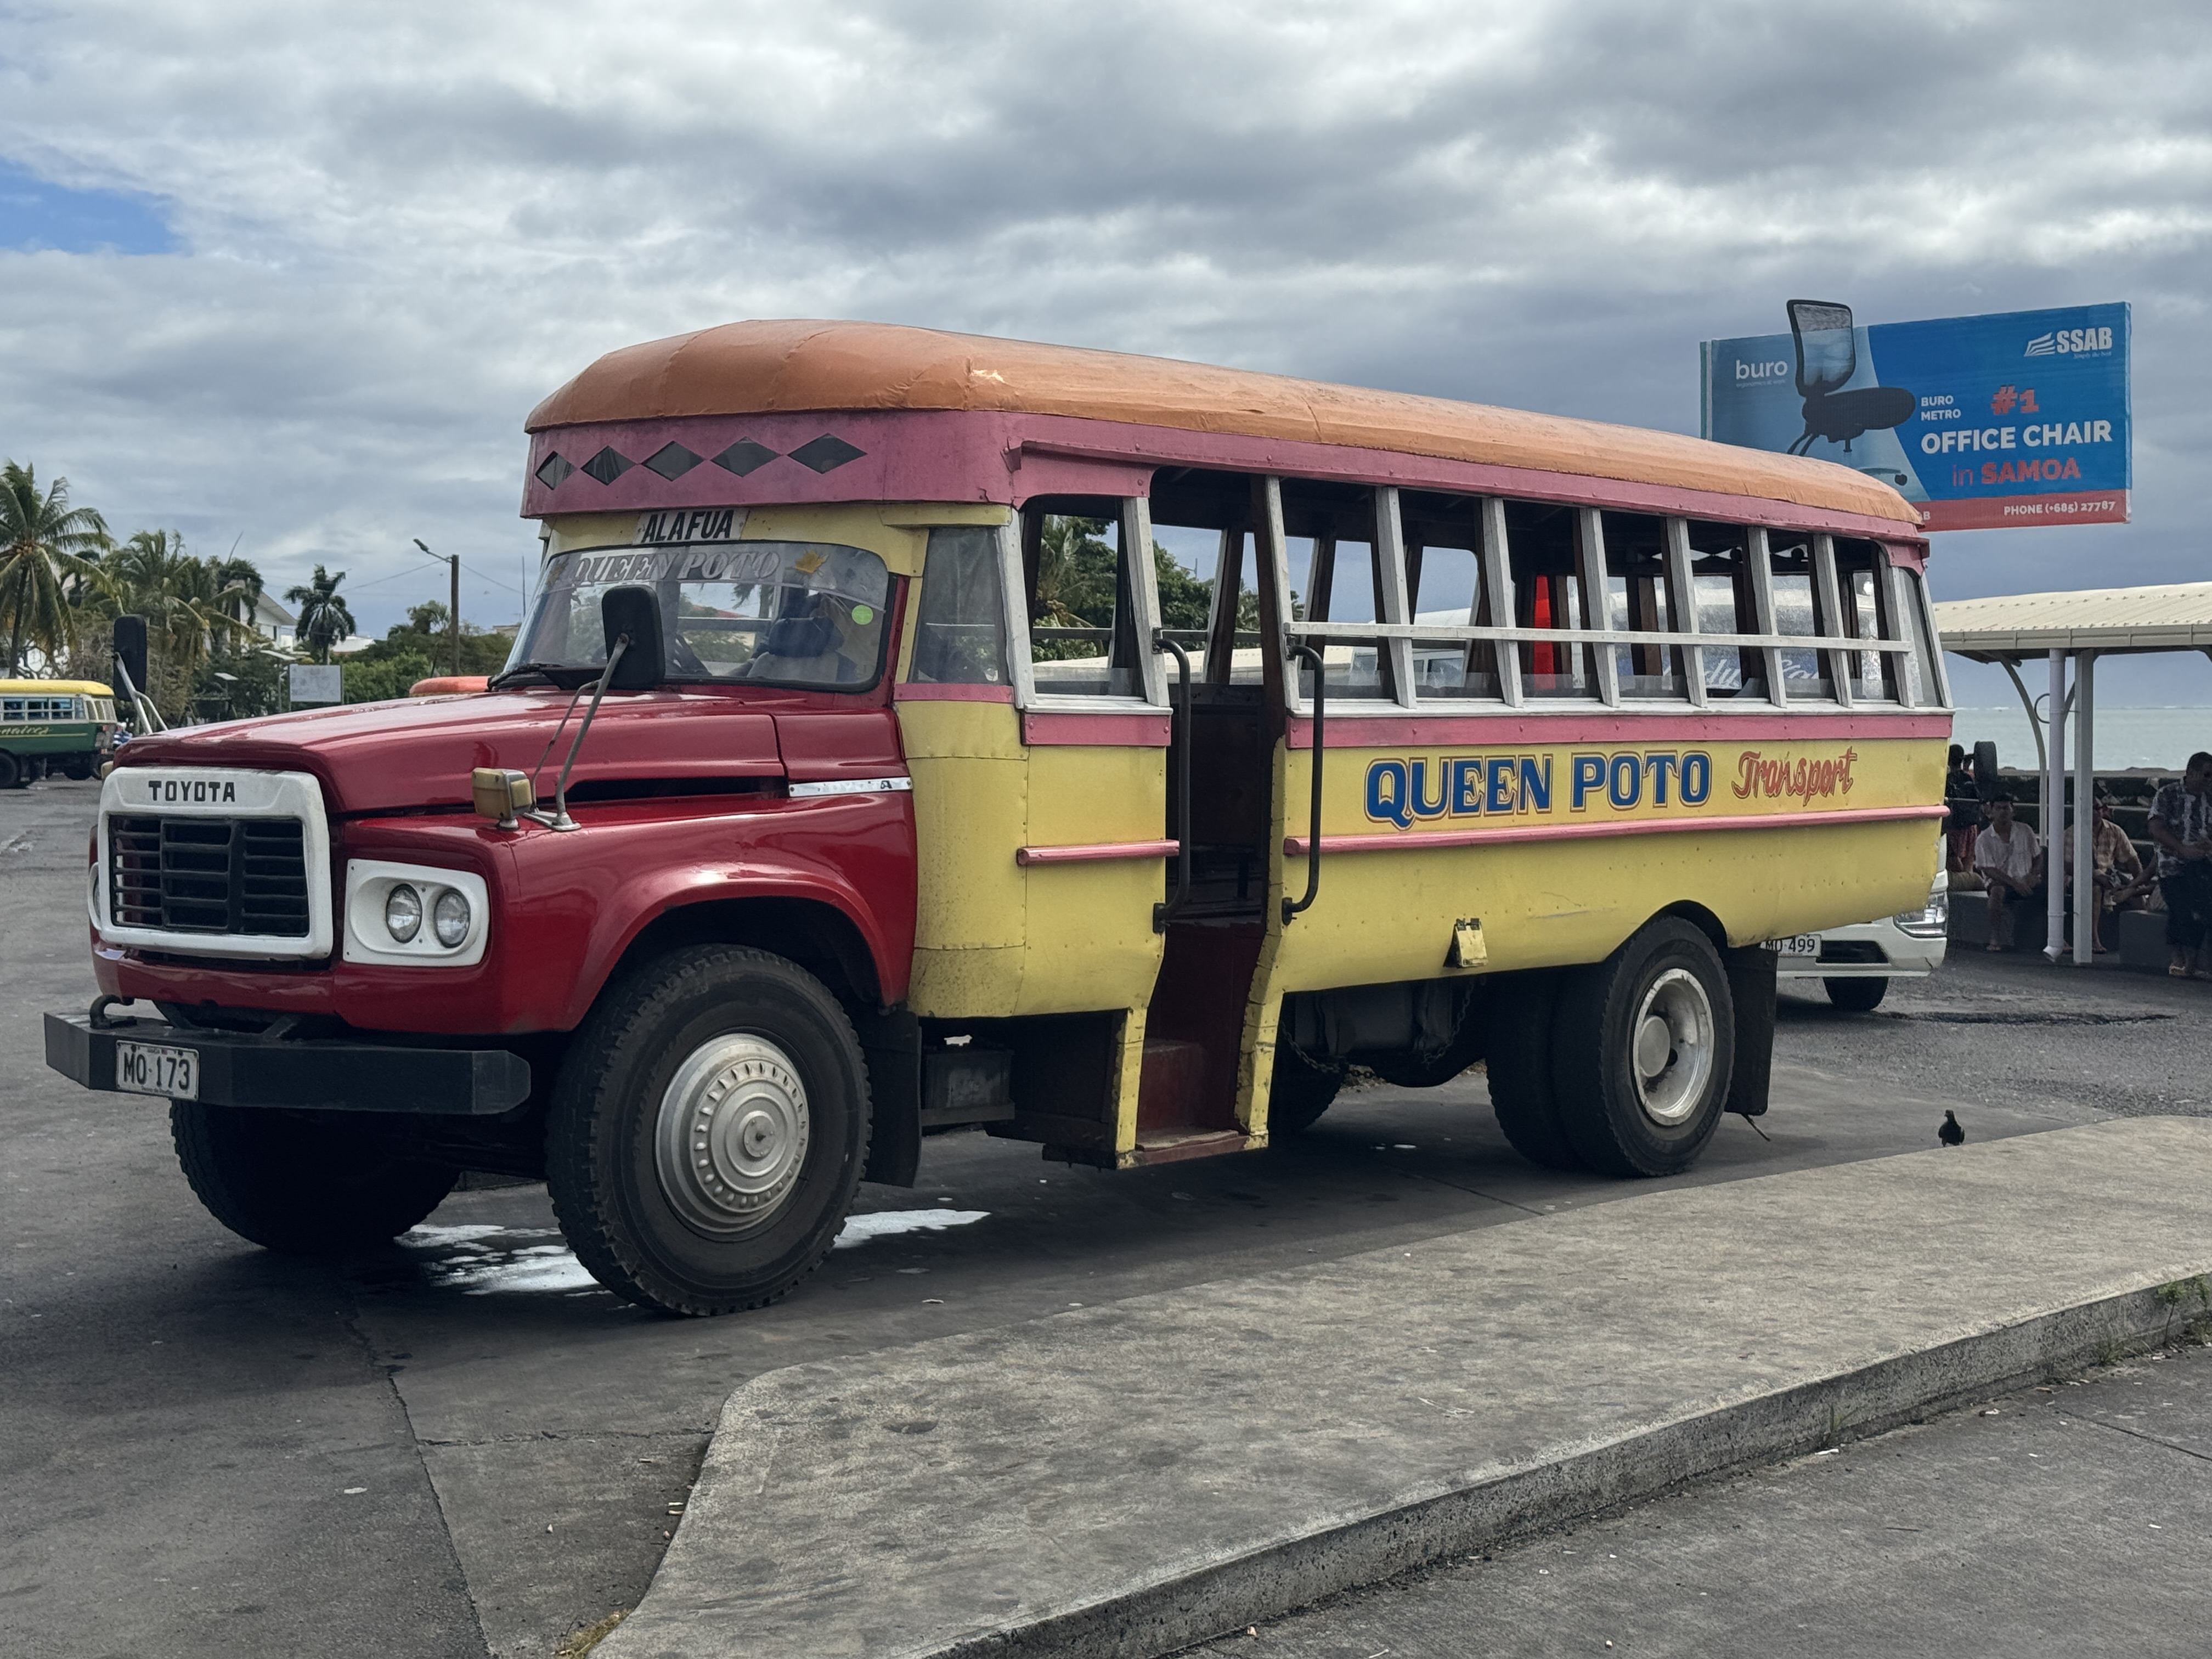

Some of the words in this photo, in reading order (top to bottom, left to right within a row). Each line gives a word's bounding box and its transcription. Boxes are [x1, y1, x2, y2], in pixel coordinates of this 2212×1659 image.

[2056, 327, 2112, 353] SSAB
[1736, 359, 1788, 380] buro
[1921, 395, 1954, 407] BURO
[1921, 409, 1961, 421] METRO
[1991, 385, 2040, 415] #1
[1921, 426, 2016, 454] OFFICE
[2023, 420, 2113, 447] CHAIR
[1952, 465, 1974, 487] in
[1981, 457, 2081, 484] SAMOA
[2004, 505, 2043, 516] PHONE
[2045, 500, 2078, 515] (+685)
[641, 510, 735, 543] ALAFUA
[572, 552, 679, 586] QUEEN
[676, 551, 781, 580] POTO
[149, 781, 235, 802] TOYOTA
[1364, 753, 1554, 831] QUEEN
[1570, 750, 1713, 812] POTO
[1731, 746, 1858, 807] Transport
